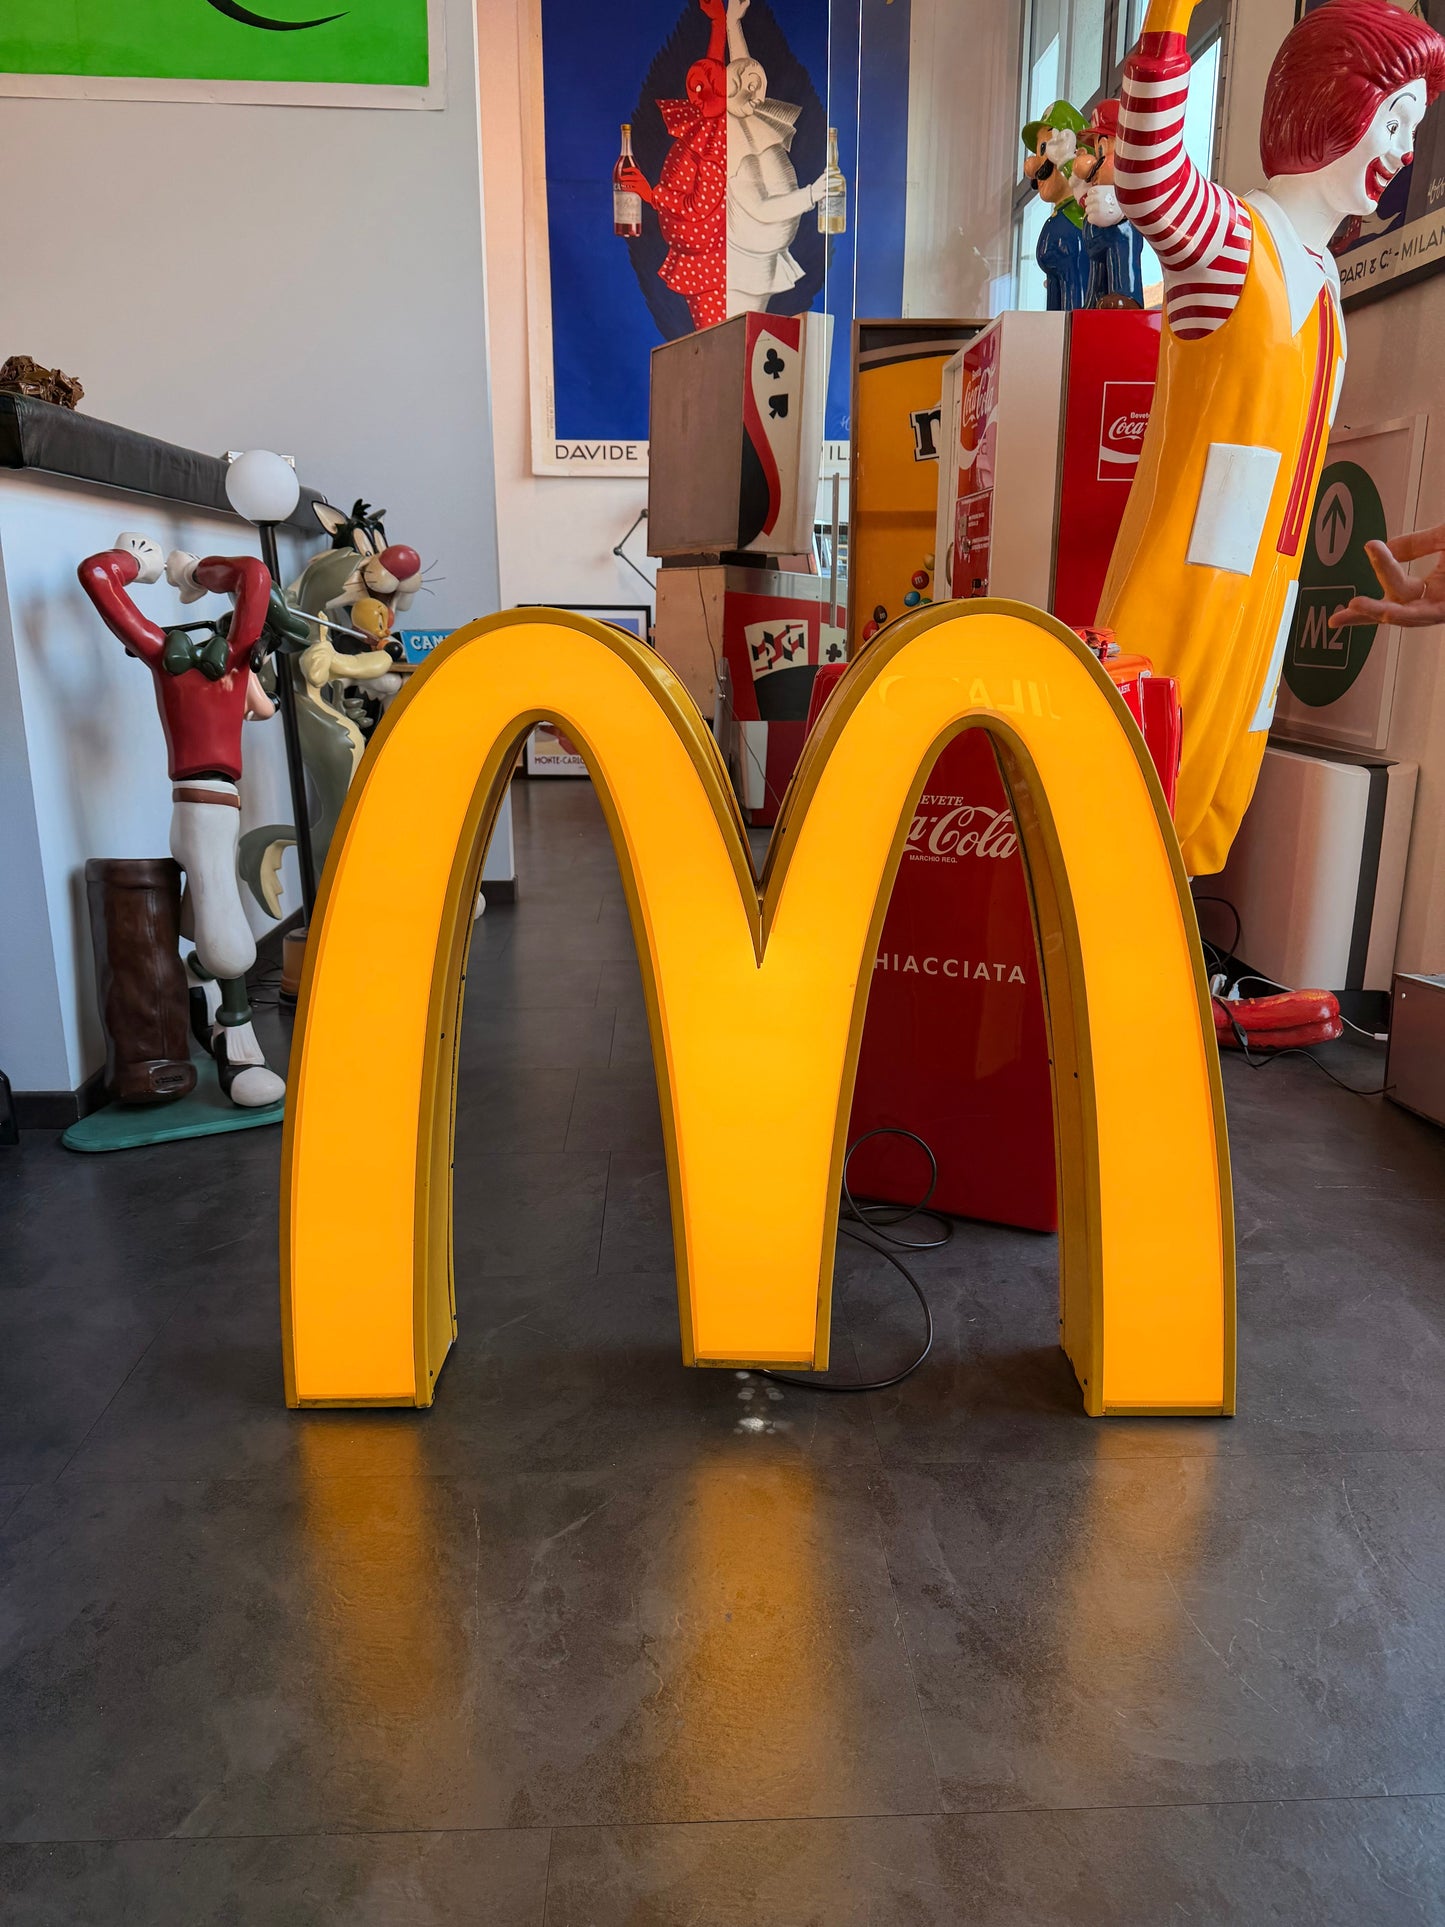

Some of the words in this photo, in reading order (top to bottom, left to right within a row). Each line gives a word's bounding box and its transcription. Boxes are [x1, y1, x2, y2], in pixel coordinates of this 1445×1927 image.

[1340, 261, 1368, 285] PARI
[1130, 411, 1150, 419] Bevet
[555, 444, 637, 460] DAVIDE
[410, 634, 450, 651] CAM
[920, 794, 964, 806] EVETE
[903, 805, 1018, 859] a-Cola
[909, 854, 940, 862] MARCHIO
[941, 856, 958, 864] REG.
[874, 952, 1026, 985] HIACCIATA
